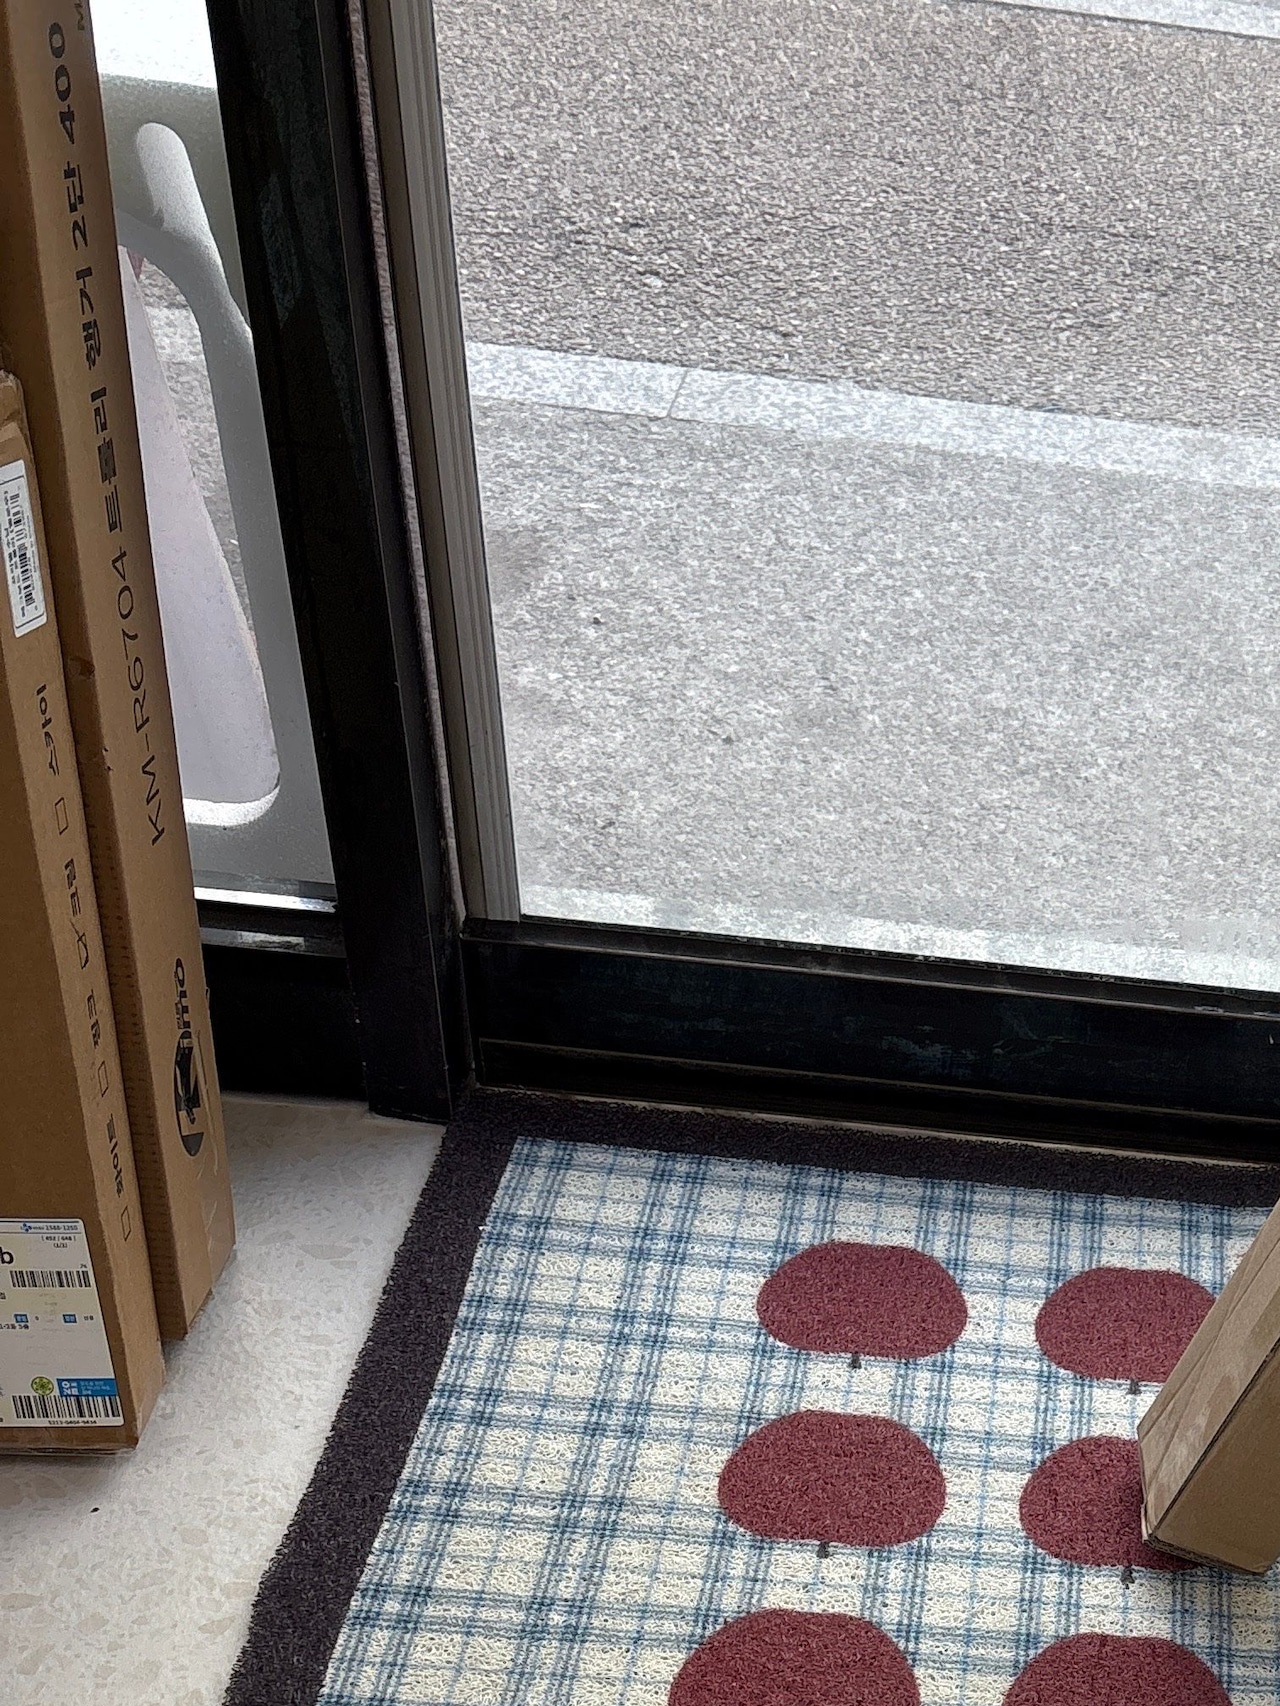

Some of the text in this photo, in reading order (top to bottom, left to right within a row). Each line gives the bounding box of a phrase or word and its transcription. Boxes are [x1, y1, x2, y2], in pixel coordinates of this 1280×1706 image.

[48, 22, 165, 846] KM-R6704 트롤리 행거 2단 400
[36, 684, 60, 776] 스카이
[106, 1112, 124, 1198] 화이트
